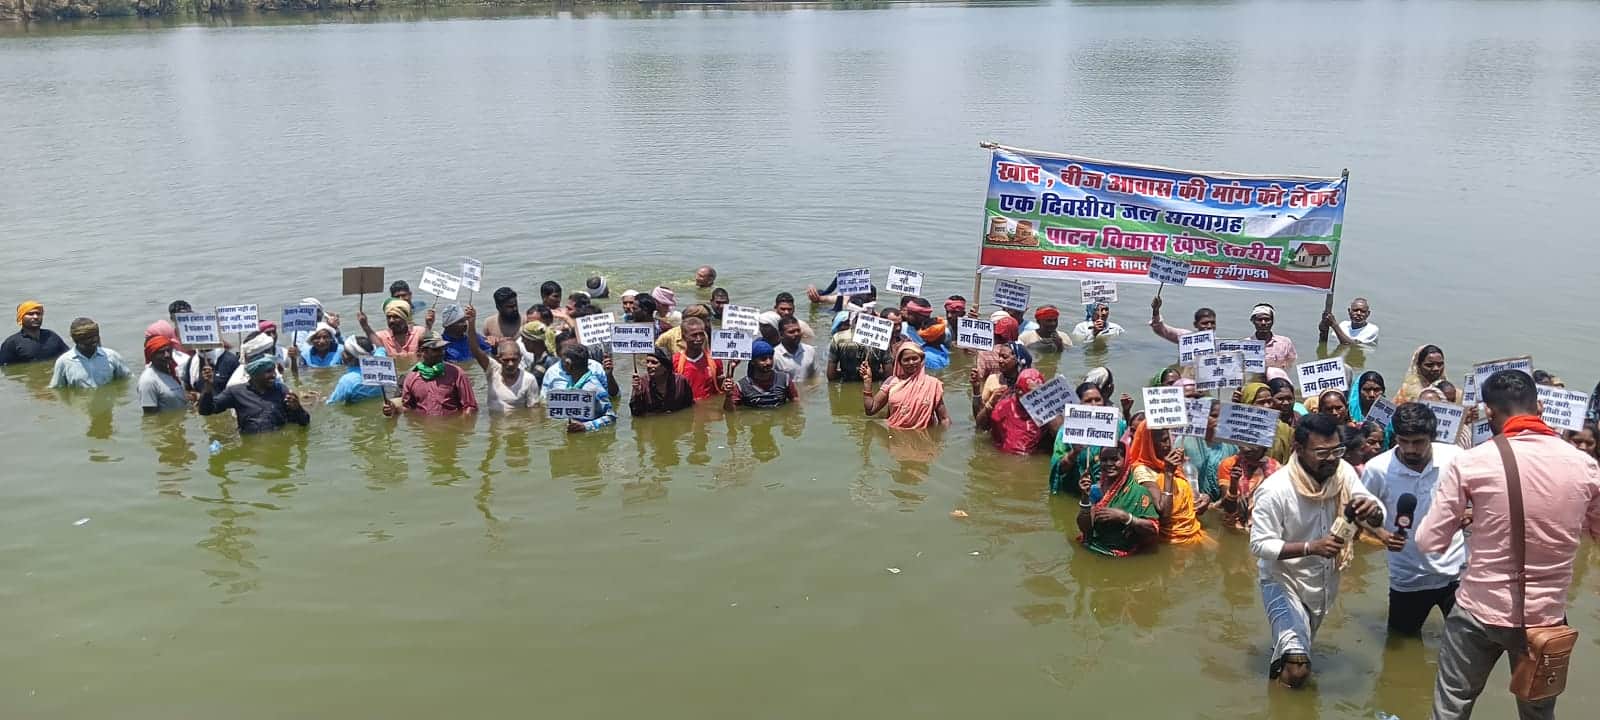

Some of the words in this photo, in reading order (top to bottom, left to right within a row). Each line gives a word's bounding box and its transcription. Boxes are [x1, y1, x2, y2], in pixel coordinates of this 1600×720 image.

[998, 162, 1041, 184] खाद
[1061, 165, 1104, 189] बीज
[1107, 174, 1173, 199] आवास
[1178, 179, 1207, 201] की
[1211, 182, 1252, 204] मांग
[1256, 185, 1288, 206] को
[1289, 185, 1341, 208] लेकर
[1000, 194, 1037, 213] एक
[1041, 192, 1117, 219] दिवसीय
[1118, 203, 1161, 222] जल
[1164, 210, 1244, 233] सत्याग्रह
[1046, 227, 1098, 247] पाटन
[1101, 227, 1169, 253] विकास
[1222, 242, 1283, 264] स्तरीय
[1042, 255, 1069, 267] स्थान
[1120, 259, 1149, 271] सागर
[961, 319, 973, 328] जय
[960, 333, 971, 344] जय
[1301, 365, 1315, 376] जय
[1303, 382, 1317, 392] जय
[1318, 377, 1345, 390] किसान
[548, 407, 563, 417] हम
